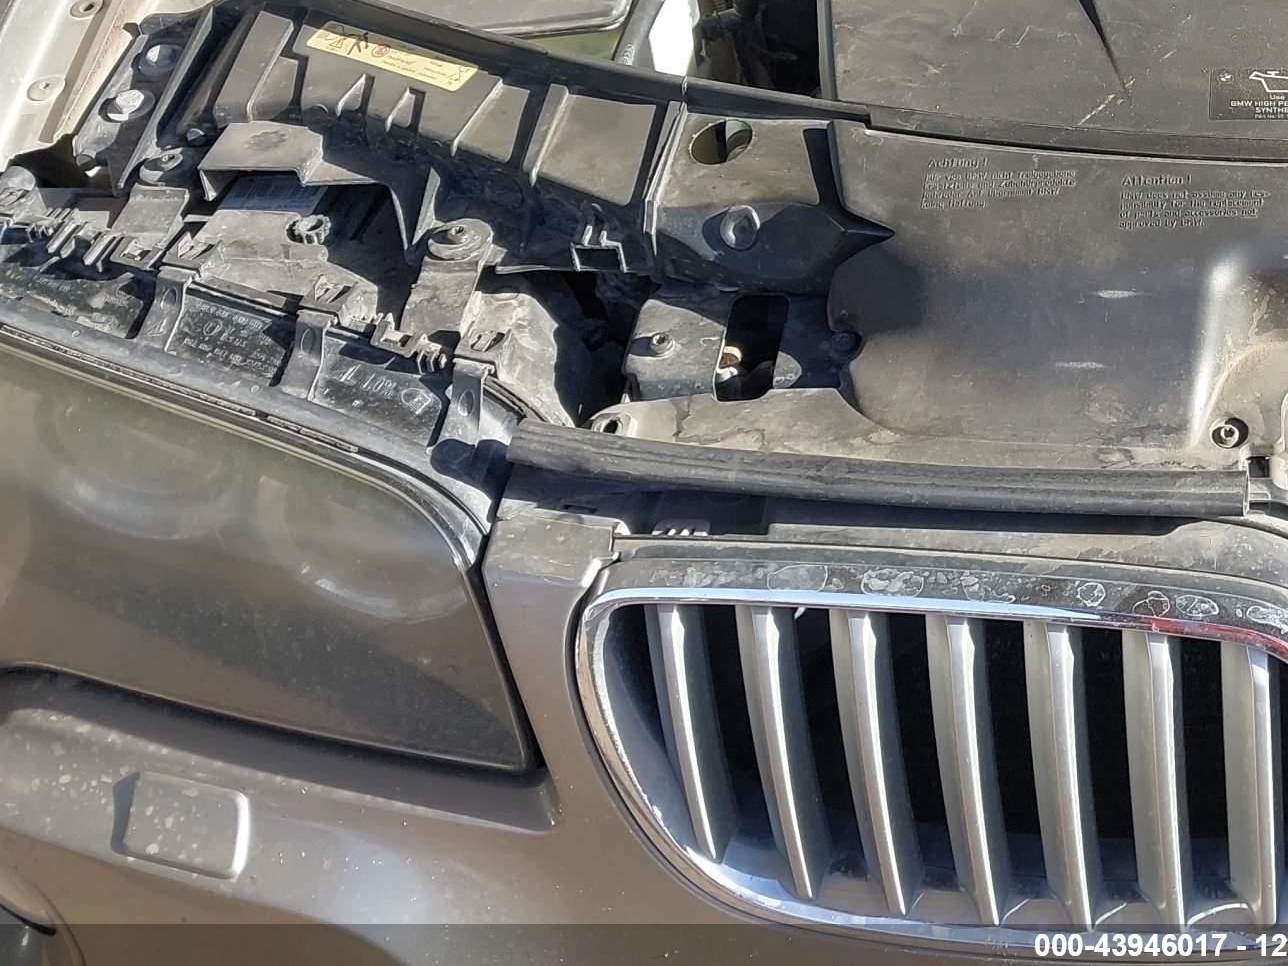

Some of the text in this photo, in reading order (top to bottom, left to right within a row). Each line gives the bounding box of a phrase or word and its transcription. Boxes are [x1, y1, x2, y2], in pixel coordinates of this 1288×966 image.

[1120, 175, 1184, 186] Attention
[1229, 190, 1247, 199] any
[1209, 198, 1264, 208] replacement
[1163, 208, 1182, 217] and
[1184, 207, 1237, 217] accessories
[1119, 219, 1162, 230] approved
